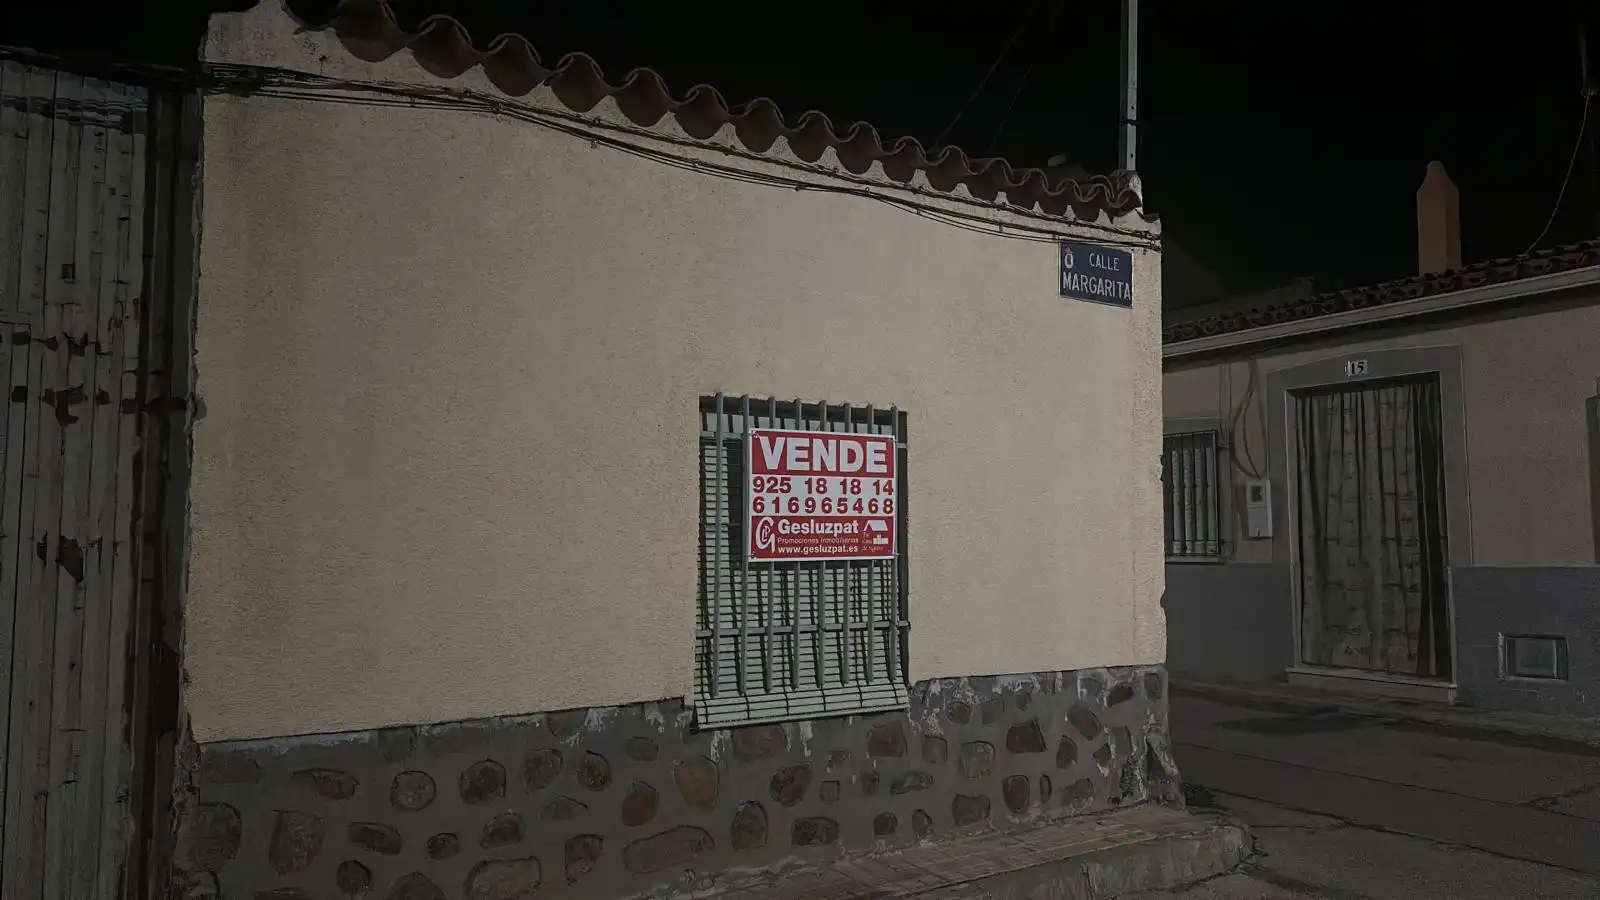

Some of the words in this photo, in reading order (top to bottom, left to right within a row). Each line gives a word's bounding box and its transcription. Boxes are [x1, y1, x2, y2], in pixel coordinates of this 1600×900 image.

[1089, 252, 1120, 271] CALLE
[1063, 271, 1131, 300] MARGARITA
[759, 436, 888, 473] VENDE
[752, 476, 792, 494] 925
[804, 477, 828, 495] 18
[839, 478, 862, 495] 18
[872, 479, 894, 495] 14
[777, 518, 859, 537] Gesluzpat
[777, 545, 859, 555] www.gesluzpat.es
